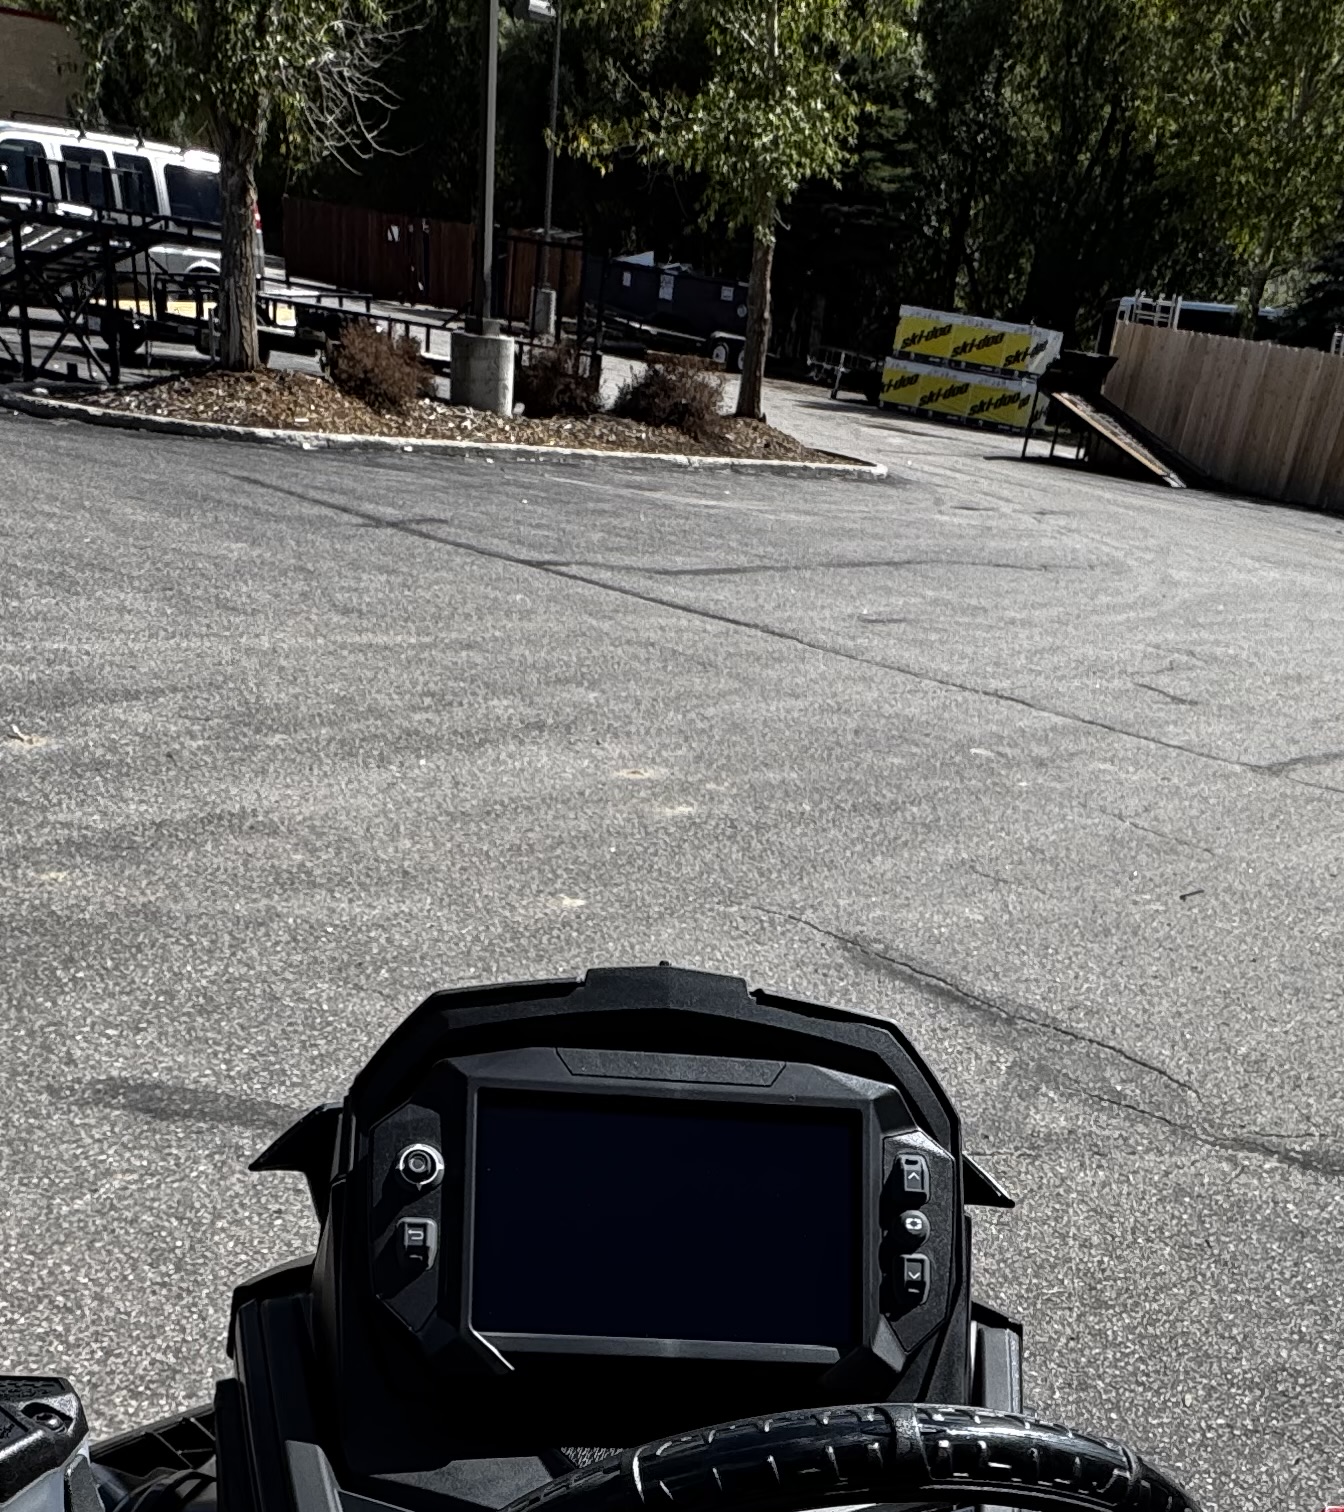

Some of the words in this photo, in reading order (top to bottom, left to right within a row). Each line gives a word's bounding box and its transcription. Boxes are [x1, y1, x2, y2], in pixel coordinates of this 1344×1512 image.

[950, 332, 1005, 358] ski-doo
[918, 382, 970, 407] ski-doo
[967, 392, 1021, 416] ski-doo
